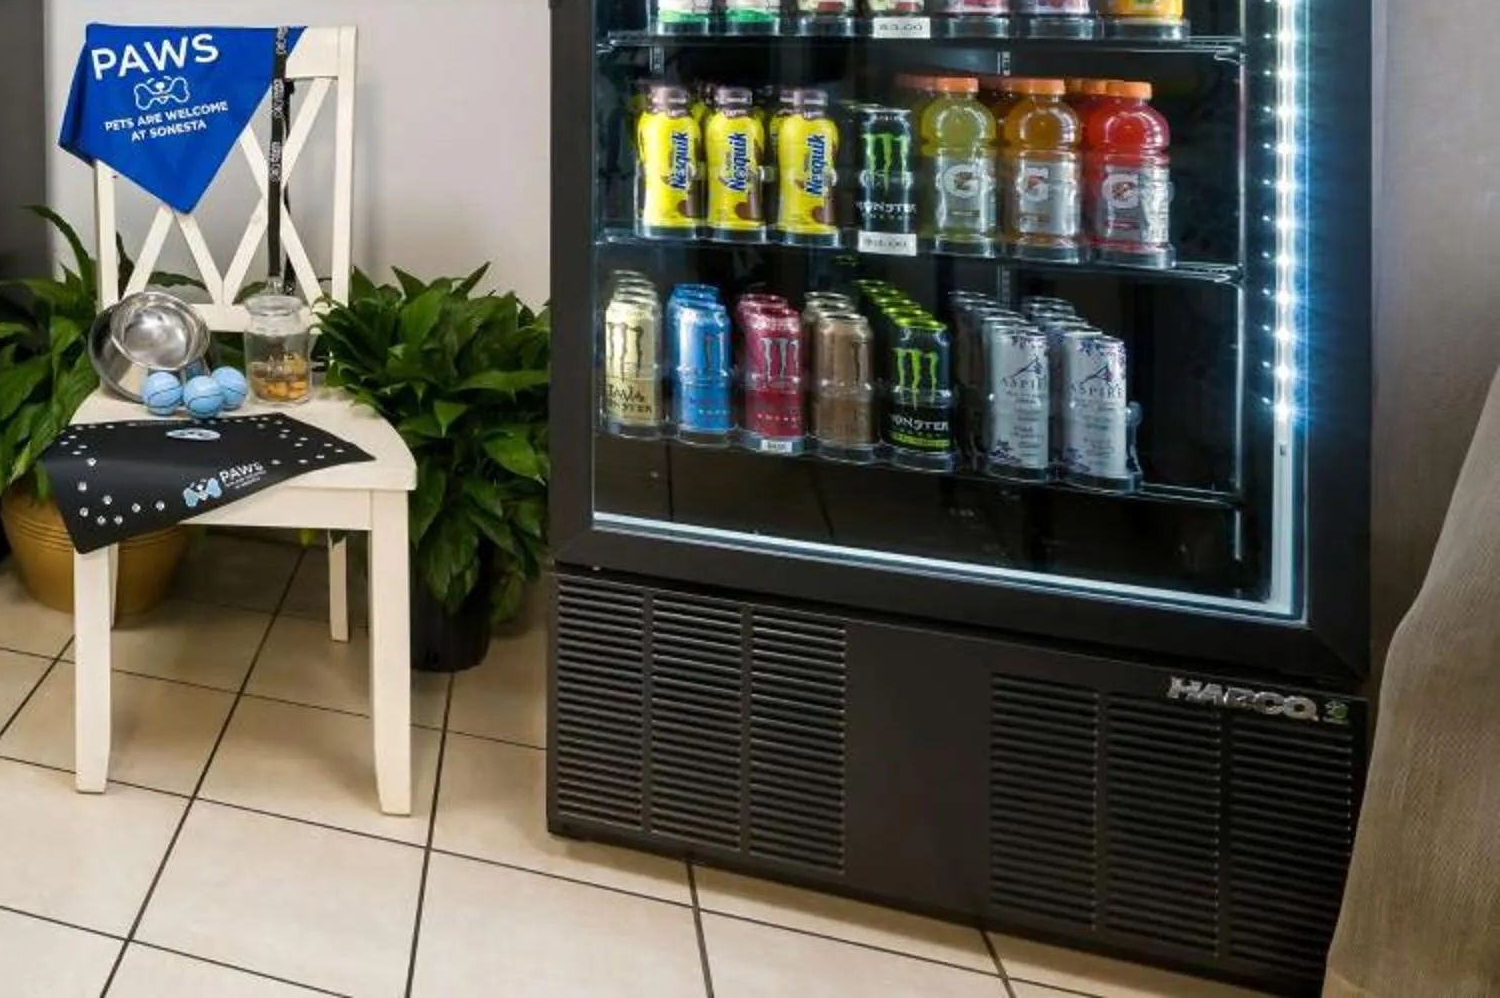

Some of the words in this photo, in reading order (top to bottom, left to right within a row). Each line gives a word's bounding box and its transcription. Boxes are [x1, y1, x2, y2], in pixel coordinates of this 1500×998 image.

[91, 33, 220, 80] PAWS
[104, 118, 135, 132] PETS
[137, 112, 163, 127] ARE
[165, 100, 230, 122] WELCOME
[131, 128, 147, 142] AT
[149, 119, 208, 139] SONESTA
[670, 131, 690, 190] Nesquik
[727, 131, 750, 191] Nesquik
[804, 134, 827, 195] Nesquik
[219, 462, 264, 483] PAWS
